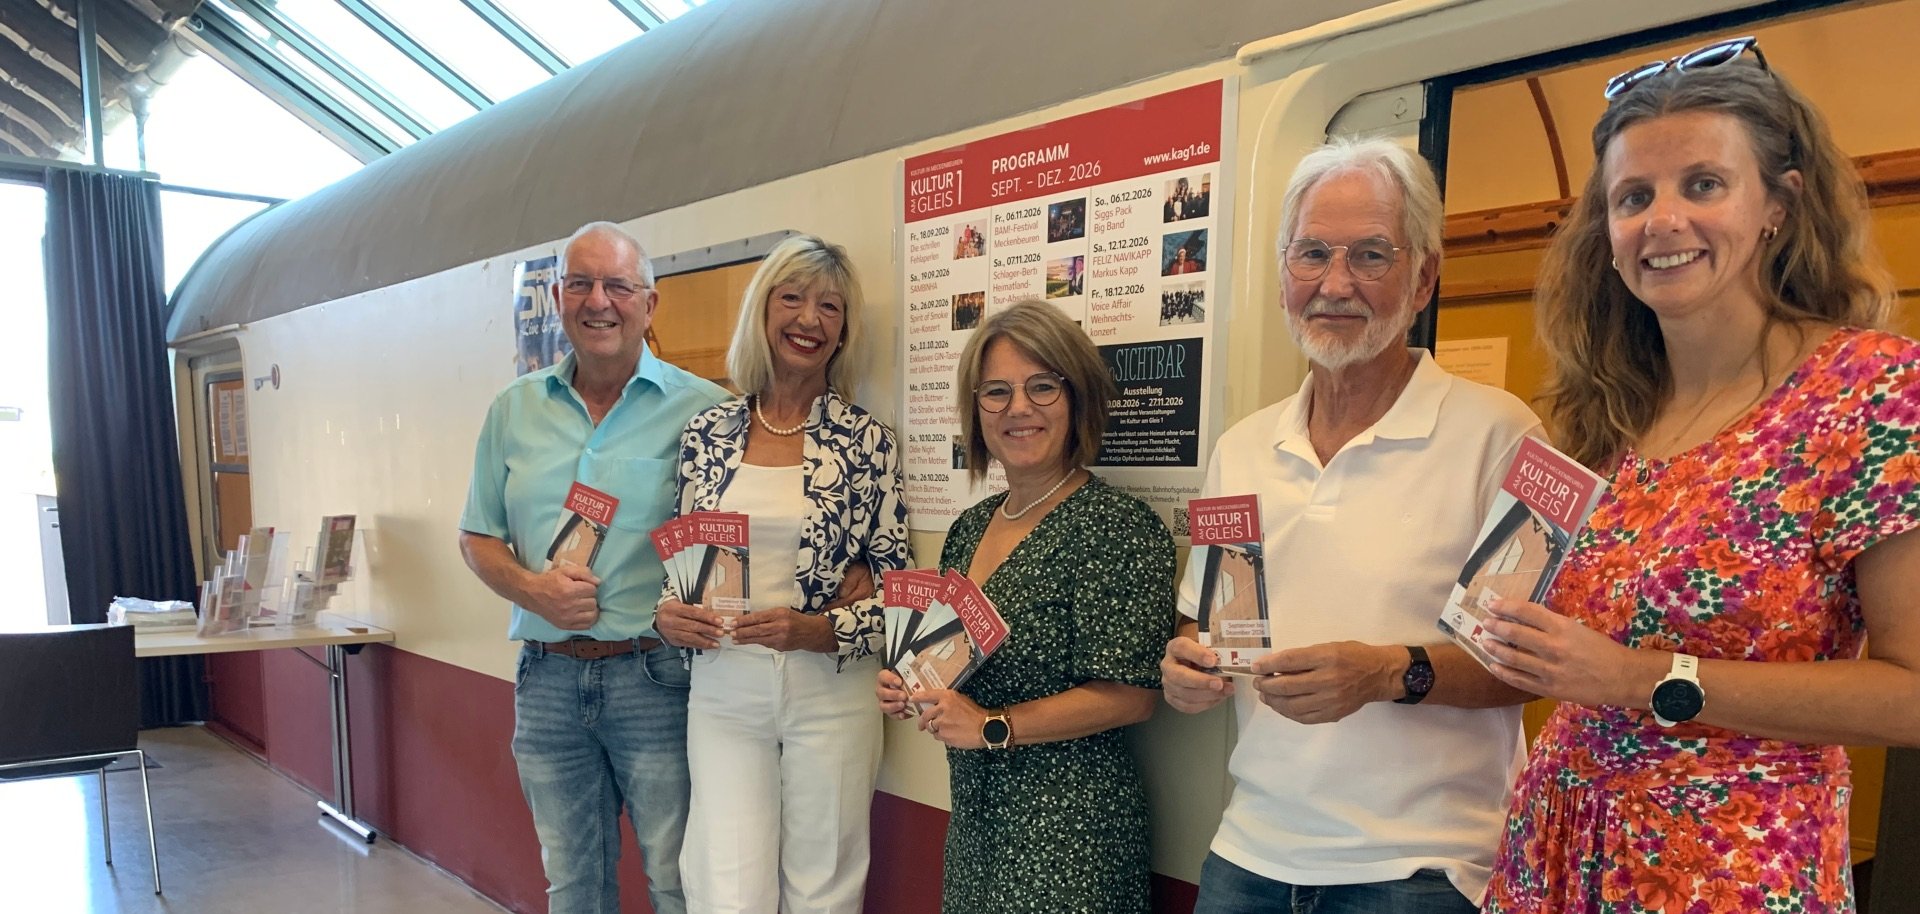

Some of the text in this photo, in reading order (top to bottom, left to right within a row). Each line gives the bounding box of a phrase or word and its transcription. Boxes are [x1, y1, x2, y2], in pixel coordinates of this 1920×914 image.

[992, 143, 1069, 174] PROGRAMM
[1143, 141, 1211, 166] www.kag1.de
[911, 172, 954, 197] KULTUR
[991, 177, 1022, 198] SEPT.
[1037, 168, 1064, 188] DEZ.
[1068, 160, 1101, 182] 2026
[917, 190, 953, 213] GLEIS
[956, 170, 963, 205] 1
[1094, 187, 1152, 206] So., 06.12.2026
[994, 206, 1042, 222] Fr., 06.11.2026
[1094, 204, 1133, 220] Siggs Pack
[920, 226, 950, 240] 18.09.2026
[994, 220, 1039, 236] BAM!-Festival
[1093, 218, 1125, 234] Big Band
[993, 234, 1040, 248] Meckenbeuren
[1093, 236, 1149, 252] Sa., 12.12.2026
[993, 252, 1042, 268] Sa., 07.11.2026
[1092, 248, 1152, 266] FELIZ NAVIKAPP
[921, 268, 950, 281] 19.09.2026
[1092, 265, 1138, 279] Markus Kapp
[992, 280, 1031, 293] Heimatland-
[1091, 283, 1145, 298] Fr., 18.12.2026
[920, 300, 949, 310] 26.09.2026
[1091, 298, 1132, 312] Voice Affair
[930, 312, 948, 320] Smoke
[1091, 312, 1136, 325] Weihnachts-
[910, 324, 940, 334] Live-Konzert
[1089, 326, 1117, 338] konzert
[919, 340, 949, 350] 11.10.2026
[1108, 343, 1186, 382] nSICHTBAR
[920, 382, 950, 390] 05.10.2026
[1123, 385, 1163, 397] Ausstellung
[1106, 398, 1140, 408] 0.08.2026
[1148, 396, 1184, 406] 27.11.2026
[920, 474, 950, 482] 26.10.2026
[1519, 460, 1570, 502] KULTUR
[573, 492, 606, 511] KULTUR
[1512, 475, 1580, 523] AM GLEIS 1
[575, 502, 602, 519] GLEIS
[699, 522, 736, 532] KULTUR
[1197, 512, 1242, 527] KULTUR
[1205, 525, 1244, 540] GLEIS
[1244, 511, 1252, 538] 1
[705, 532, 736, 542] GLEIS
[737, 525, 743, 544] 1
[911, 595, 932, 608] GLE
[962, 594, 991, 633] KULTUR
[960, 608, 985, 640] GLEIS
